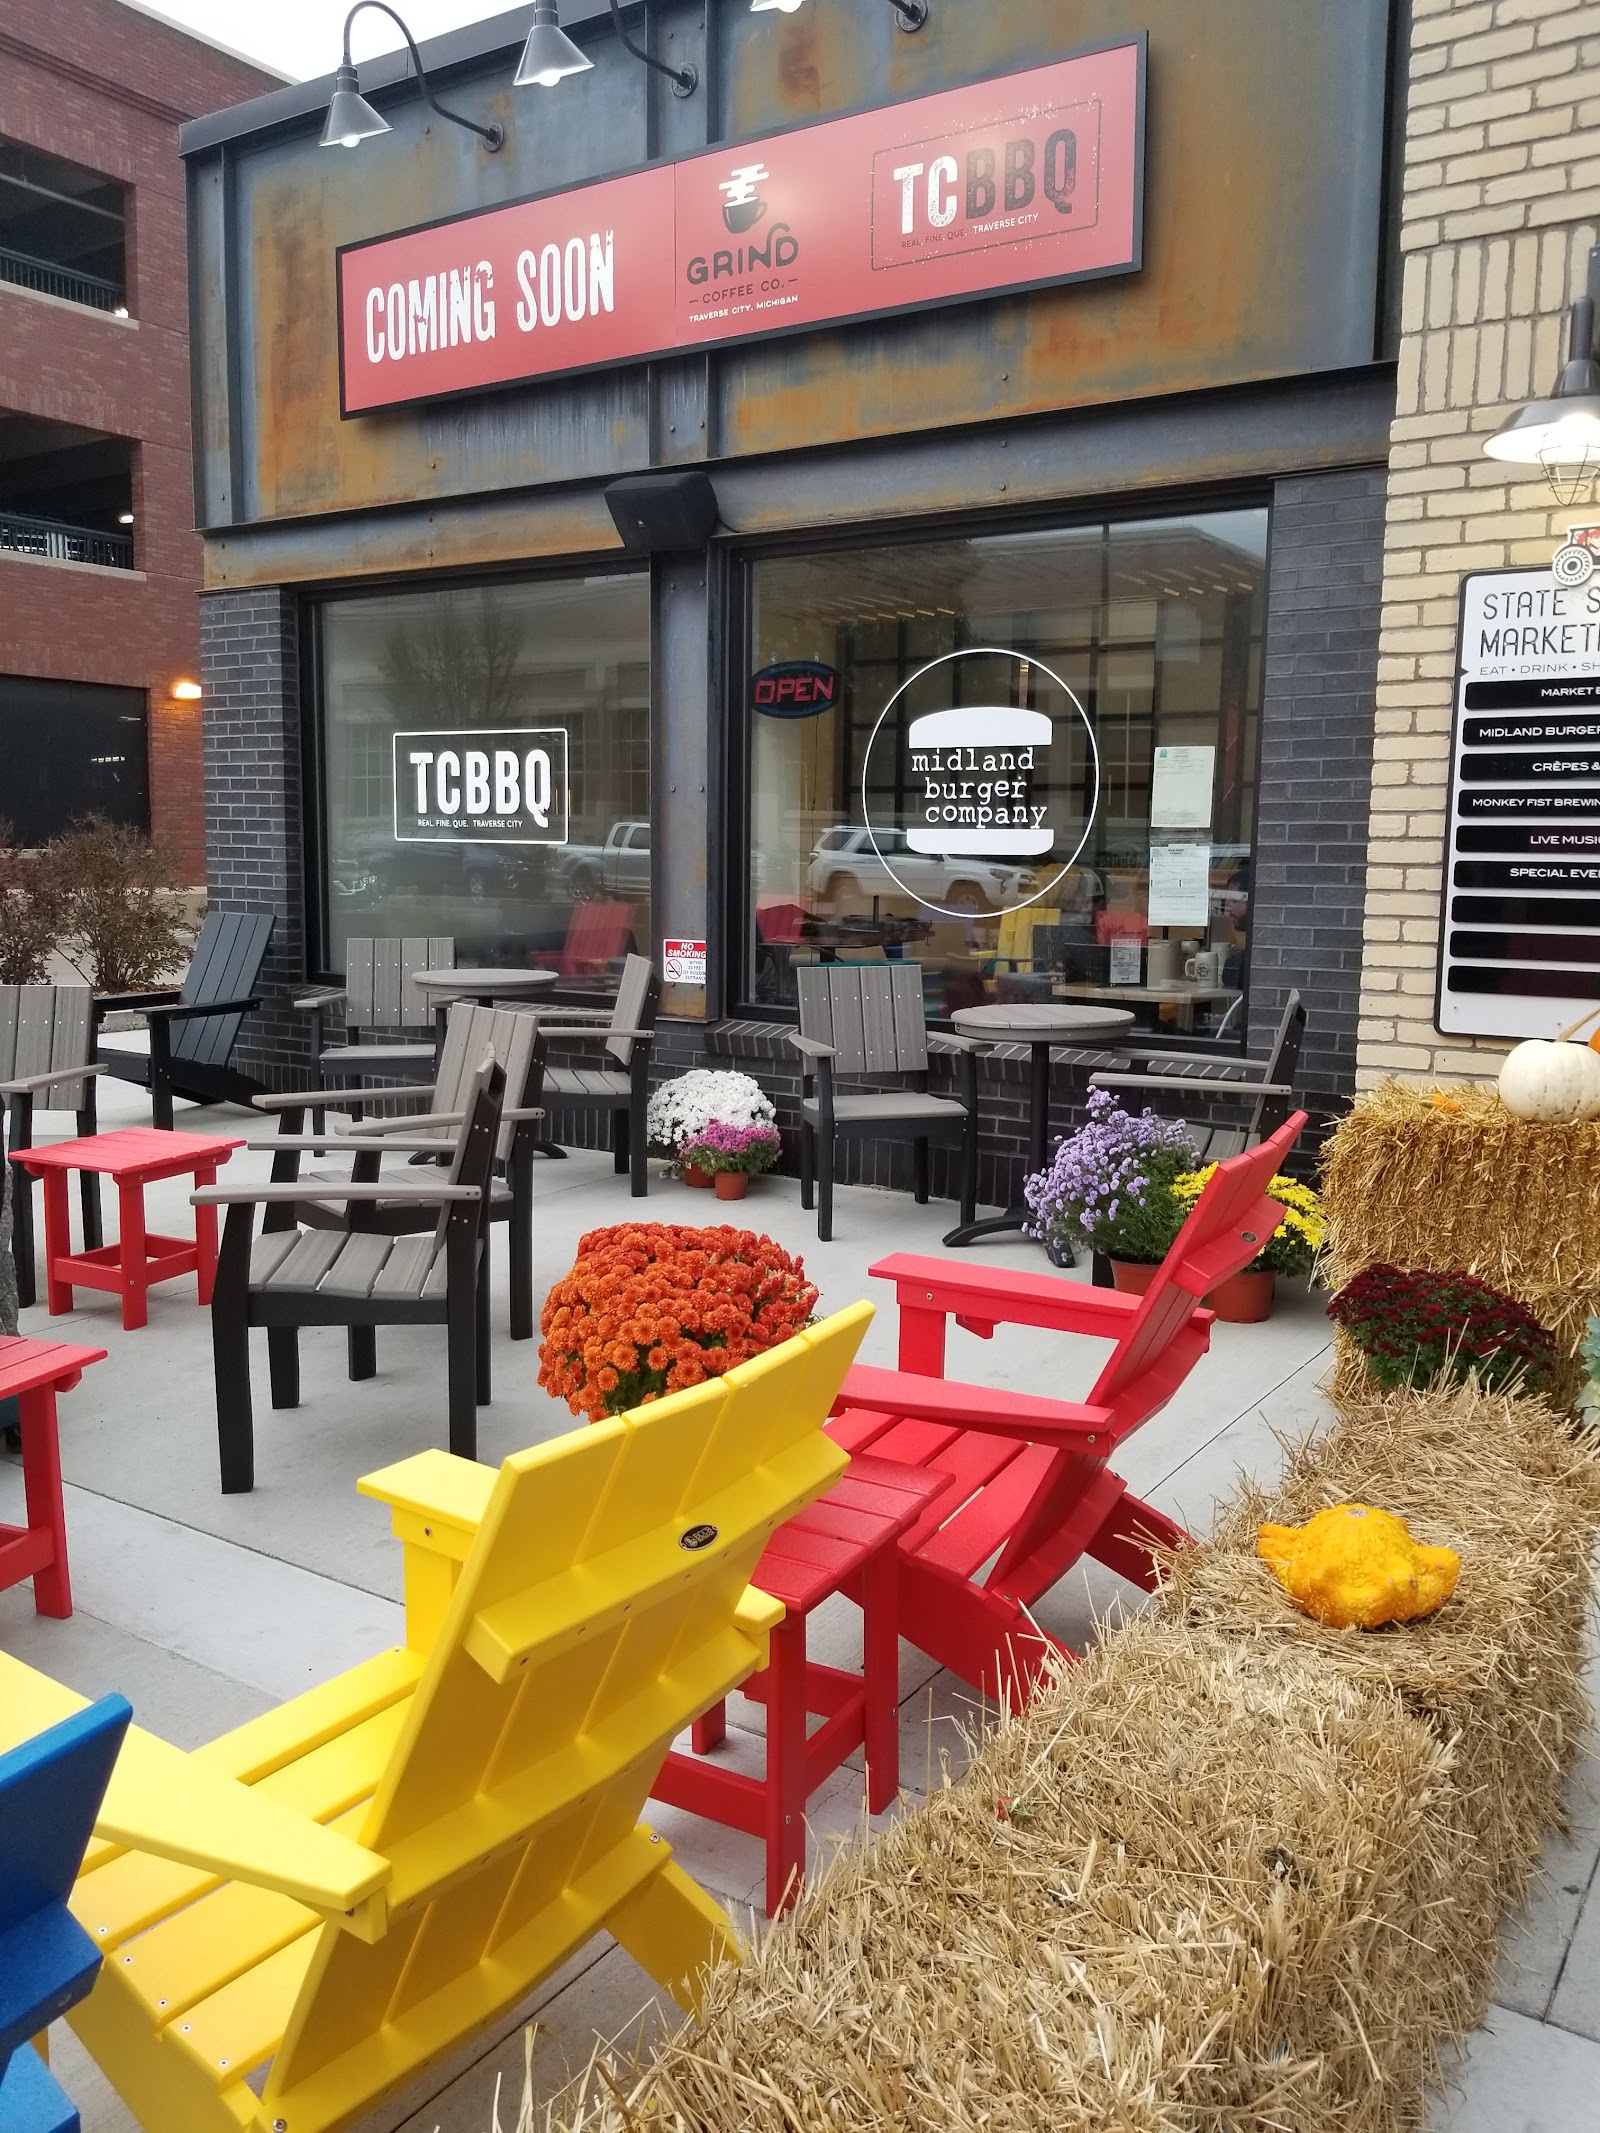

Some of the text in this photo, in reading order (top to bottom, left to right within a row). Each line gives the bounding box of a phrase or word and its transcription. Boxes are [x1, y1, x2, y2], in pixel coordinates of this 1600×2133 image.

[893, 128, 1077, 235] TCBBQ
[901, 212, 1039, 249] REAL. FINE. QUE. TRAVERSE CITY
[686, 222, 799, 285] GRIND
[366, 229, 614, 363] COMING SOON
[702, 278, 785, 304] COFFEE CO.
[688, 294, 798, 323] TRAVERSE CITY, MICHIGAN
[1482, 588, 1569, 620] STATE
[1479, 622, 1600, 658] MARKET
[1479, 664, 1509, 676] EAT
[1520, 662, 1568, 674] DRINK
[754, 675, 834, 704] OPEN
[1540, 686, 1595, 697] MARKET
[1479, 726, 1543, 738] MIDLAND
[911, 746, 1035, 772] midland
[1532, 760, 1590, 772] CRÊPES
[409, 749, 551, 828] TCBBQ
[924, 776, 1028, 805] burger
[1472, 798, 1525, 808] MONKEY
[1526, 798, 1553, 808] FIST
[418, 819, 523, 829] REAL. FINE. QUE. TRAVERSE CITY
[925, 804, 1048, 829] company
[1529, 834, 1600, 845] LIVE MUSI
[1509, 867, 1600, 879] SPECIAL EVE
[668, 950, 706, 958] SMOKING
[681, 943, 694, 951] NO
